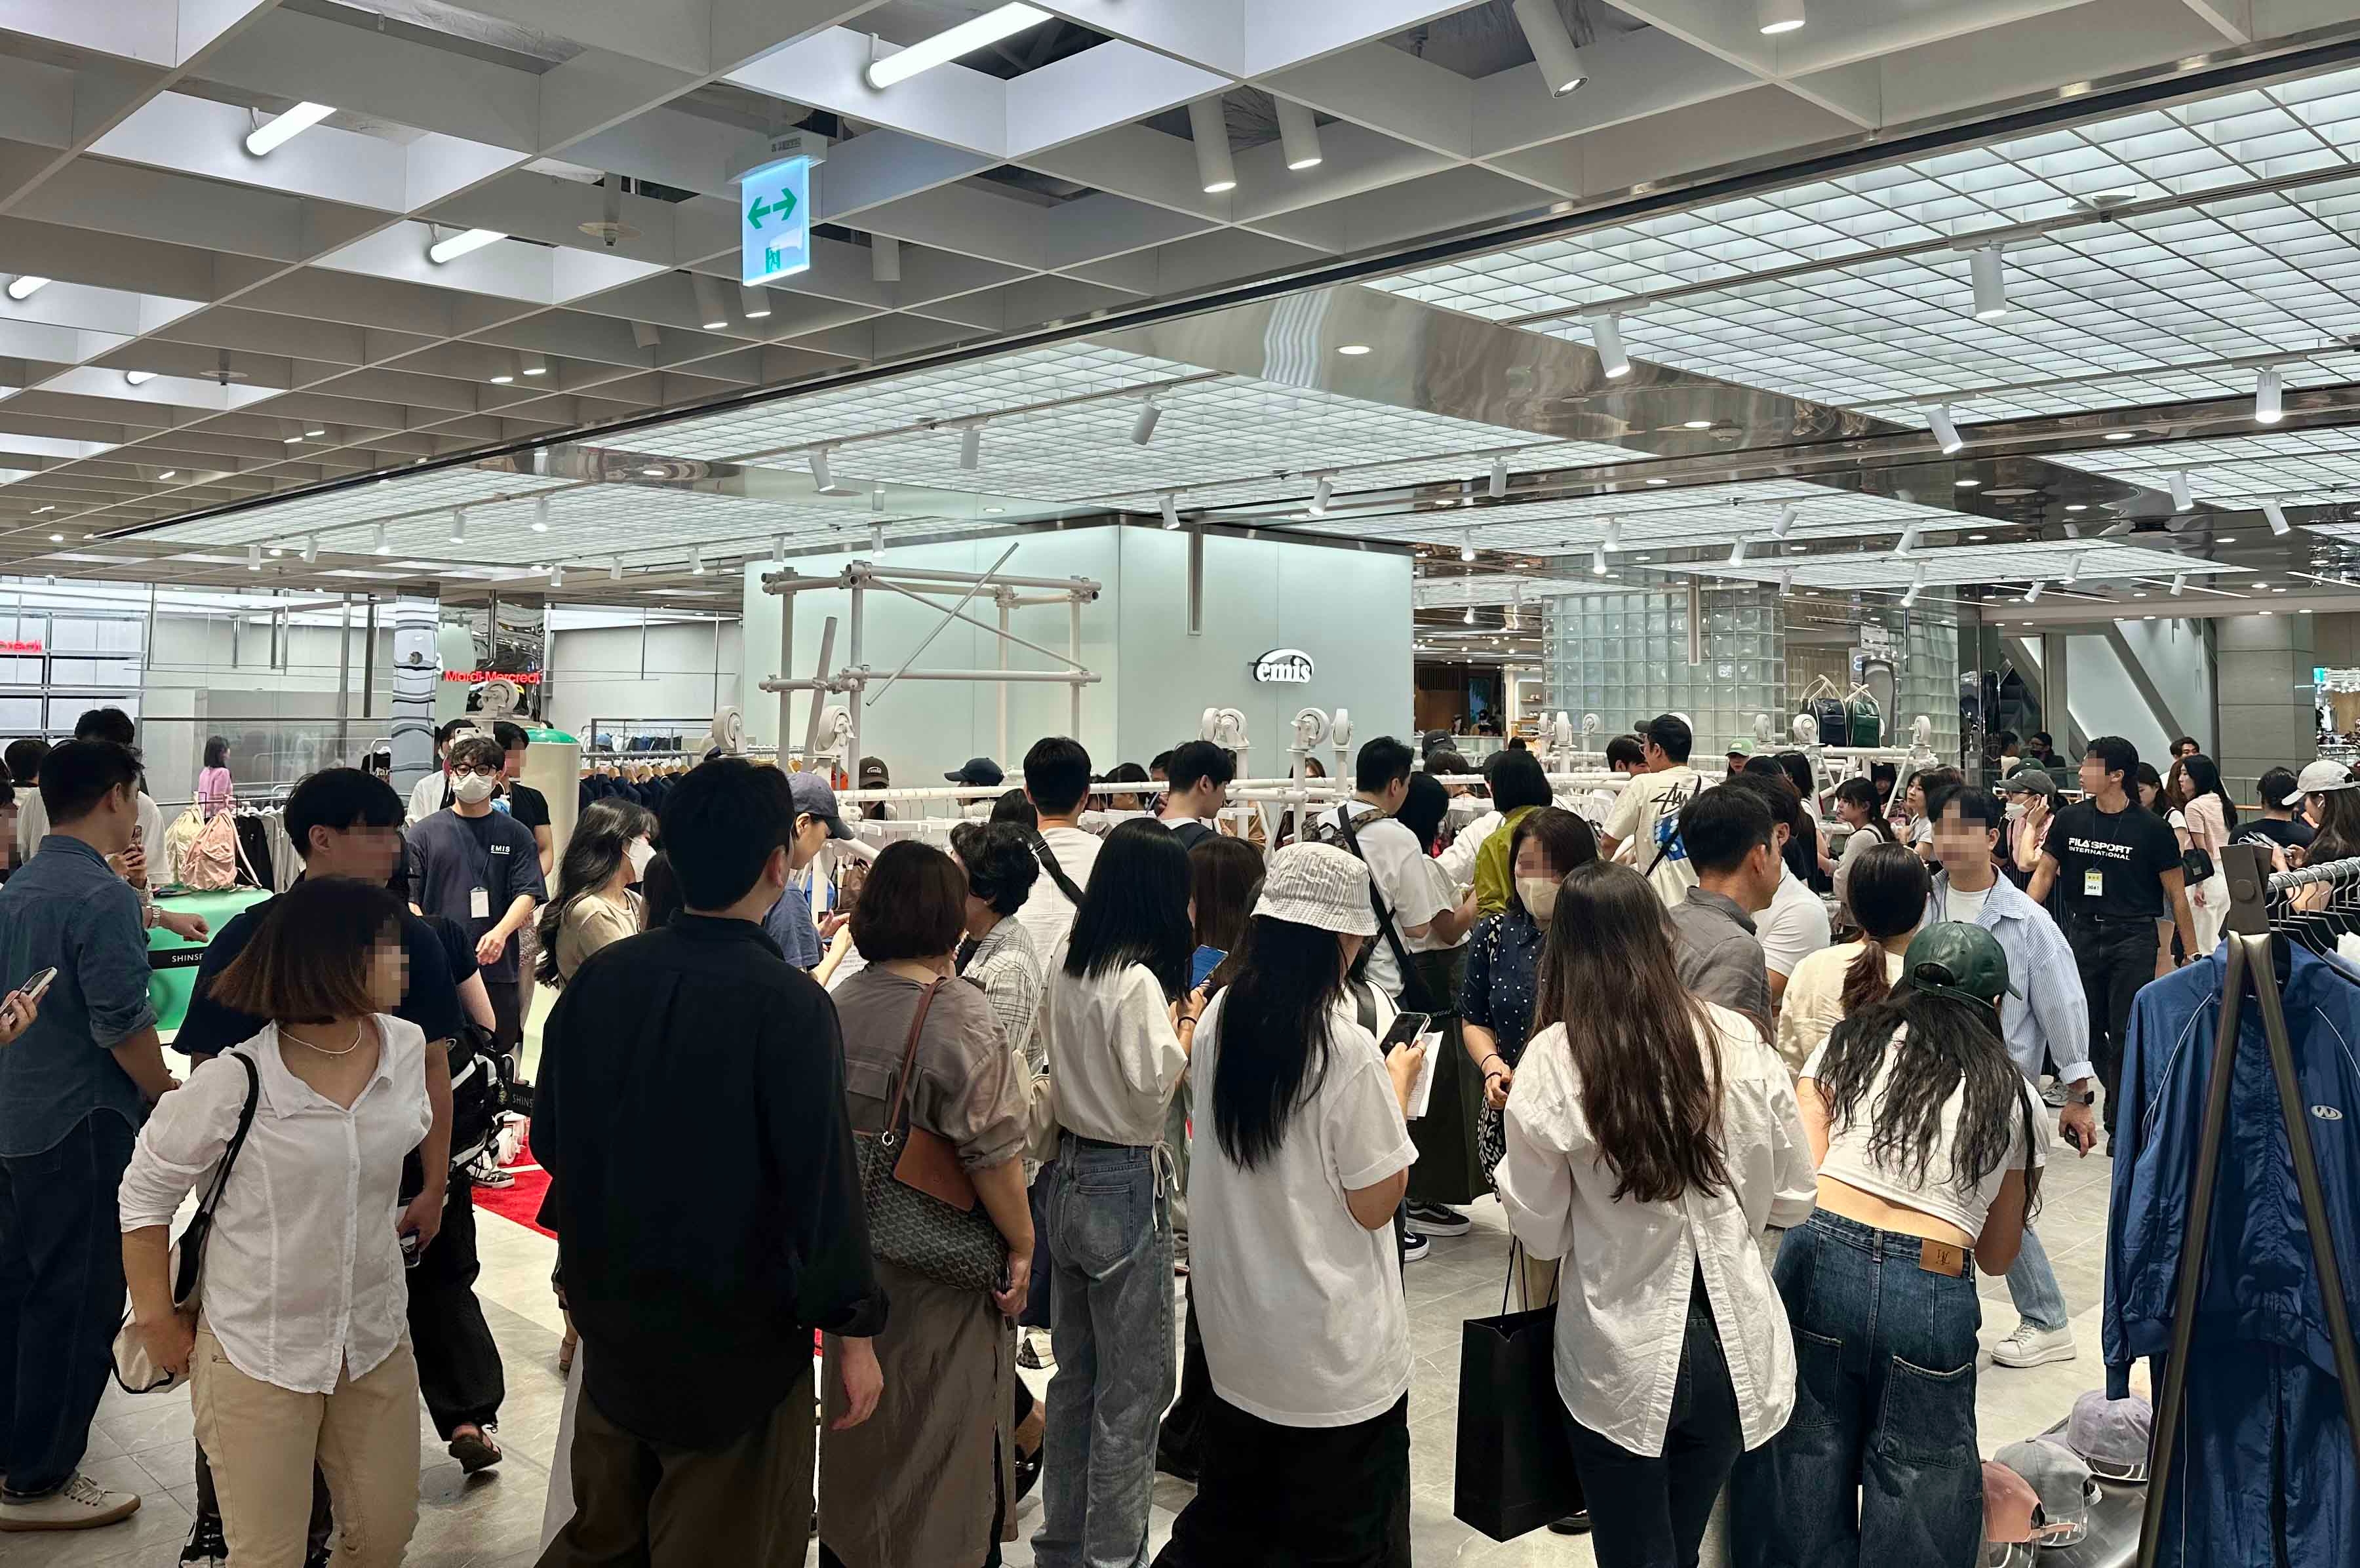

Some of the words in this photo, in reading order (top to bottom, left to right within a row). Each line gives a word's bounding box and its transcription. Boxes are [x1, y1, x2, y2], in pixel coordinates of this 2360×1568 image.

[445, 671, 482, 682] Mardi
[1256, 657, 1311, 683] emis
[2068, 838, 2090, 848] FILA
[2091, 841, 2133, 854] SPORT
[2068, 846, 2131, 861] INTERNATIONAL
